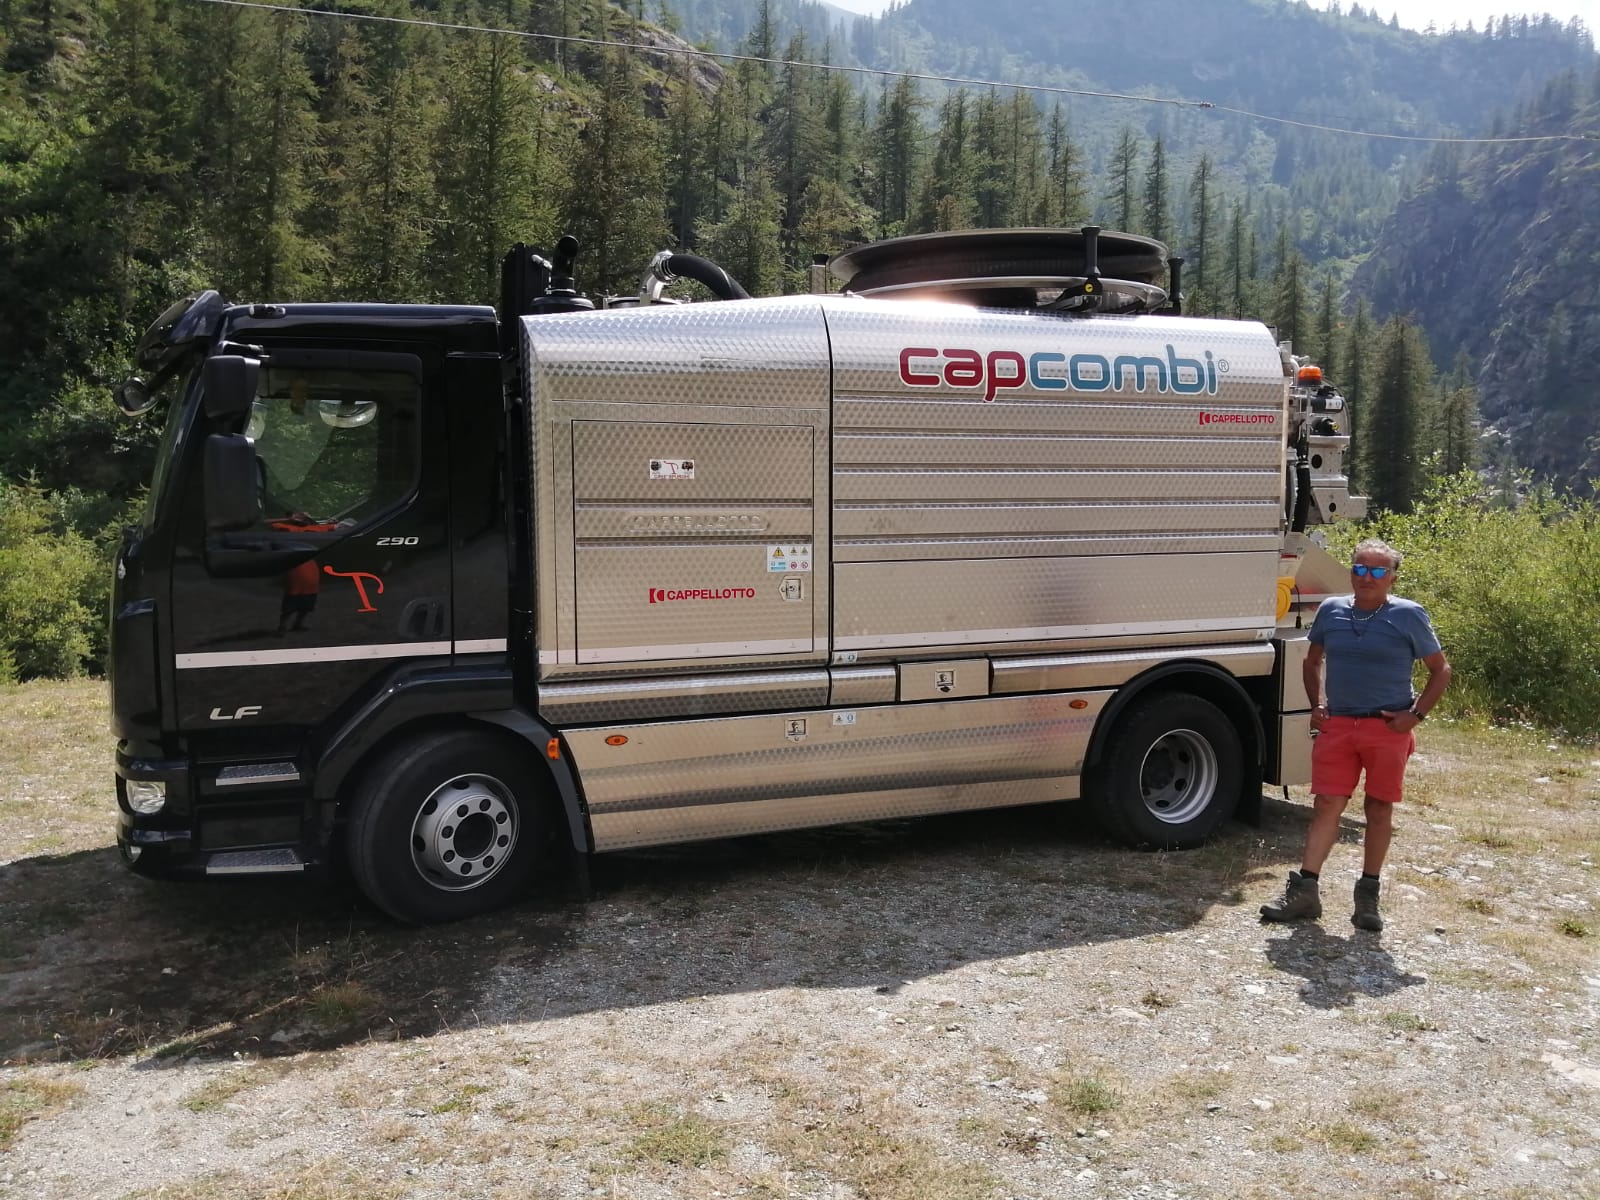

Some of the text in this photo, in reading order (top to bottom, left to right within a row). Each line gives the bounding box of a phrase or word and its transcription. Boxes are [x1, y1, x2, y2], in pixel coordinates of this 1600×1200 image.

[1211, 414, 1275, 424] CAPPELLOTTO
[376, 536, 420, 546] 290
[666, 588, 756, 601] CAPPELLOTTO
[209, 705, 263, 721] LF
